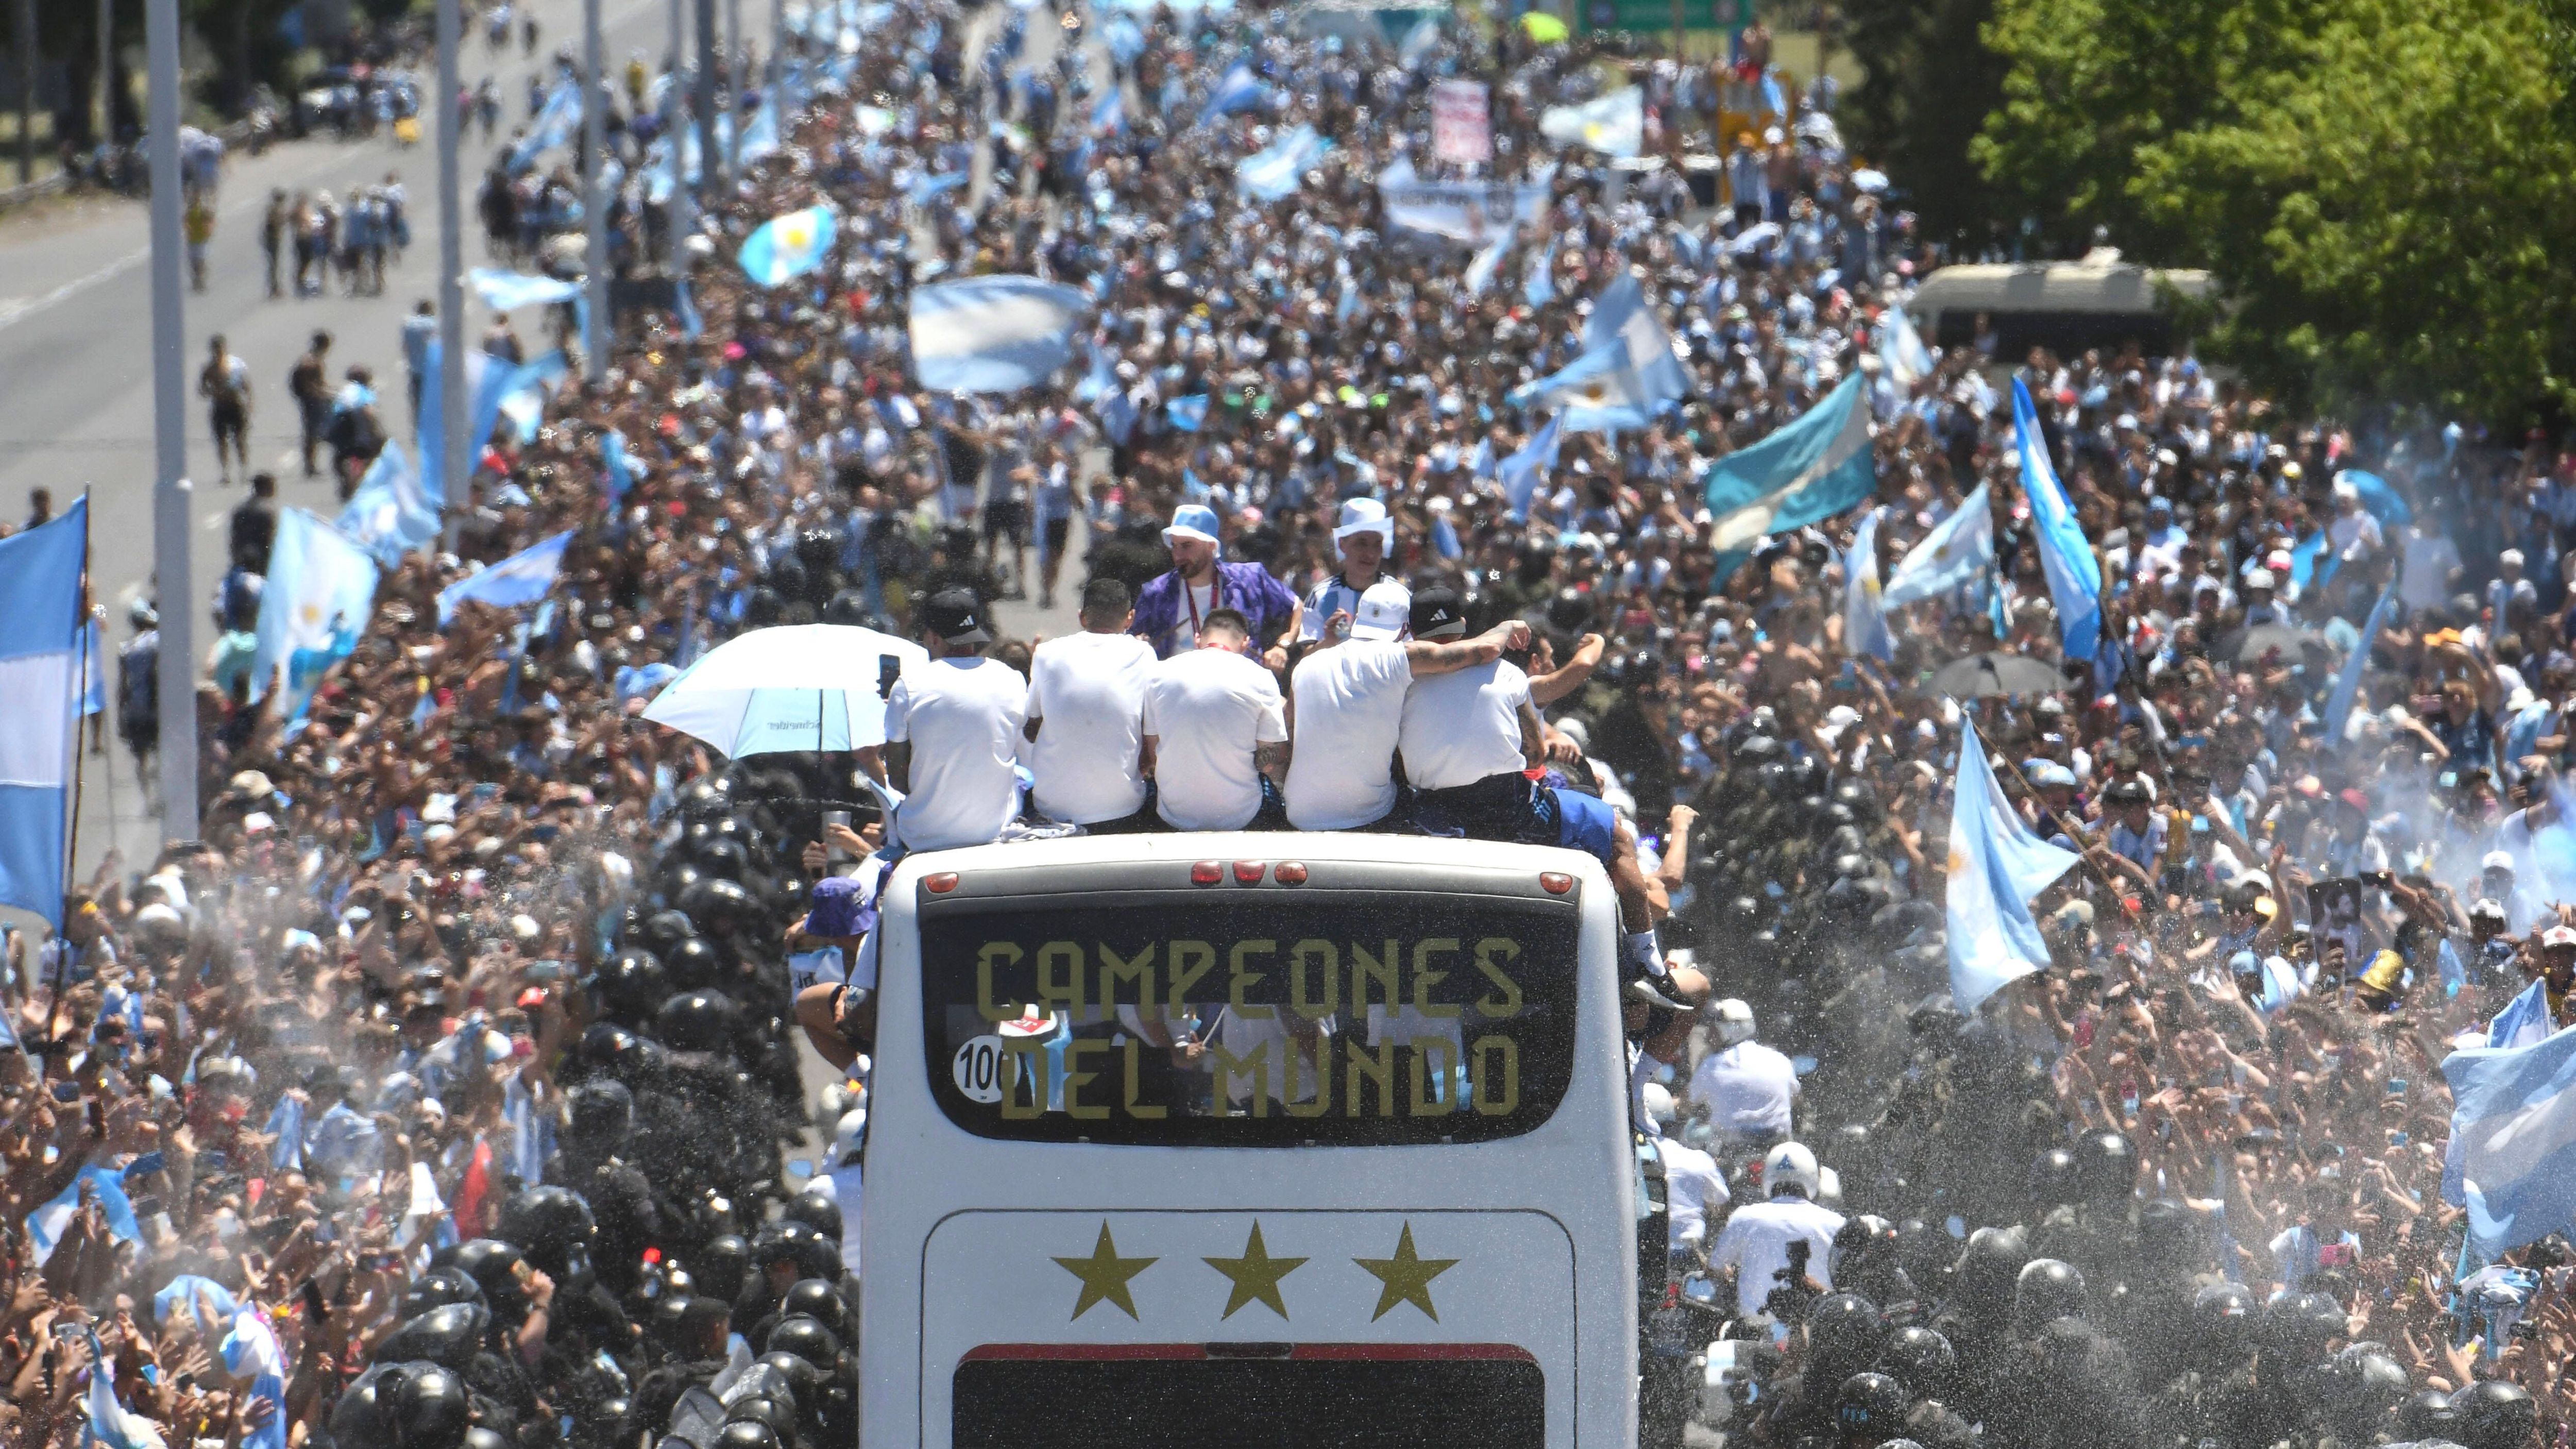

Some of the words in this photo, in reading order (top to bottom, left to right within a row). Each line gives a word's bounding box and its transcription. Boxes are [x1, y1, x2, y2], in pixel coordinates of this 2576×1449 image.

[977, 937, 1522, 1021] CAMPEONES
[1001, 1037, 1167, 1119] DEL
[1213, 1035, 1519, 1118] MUNDO
